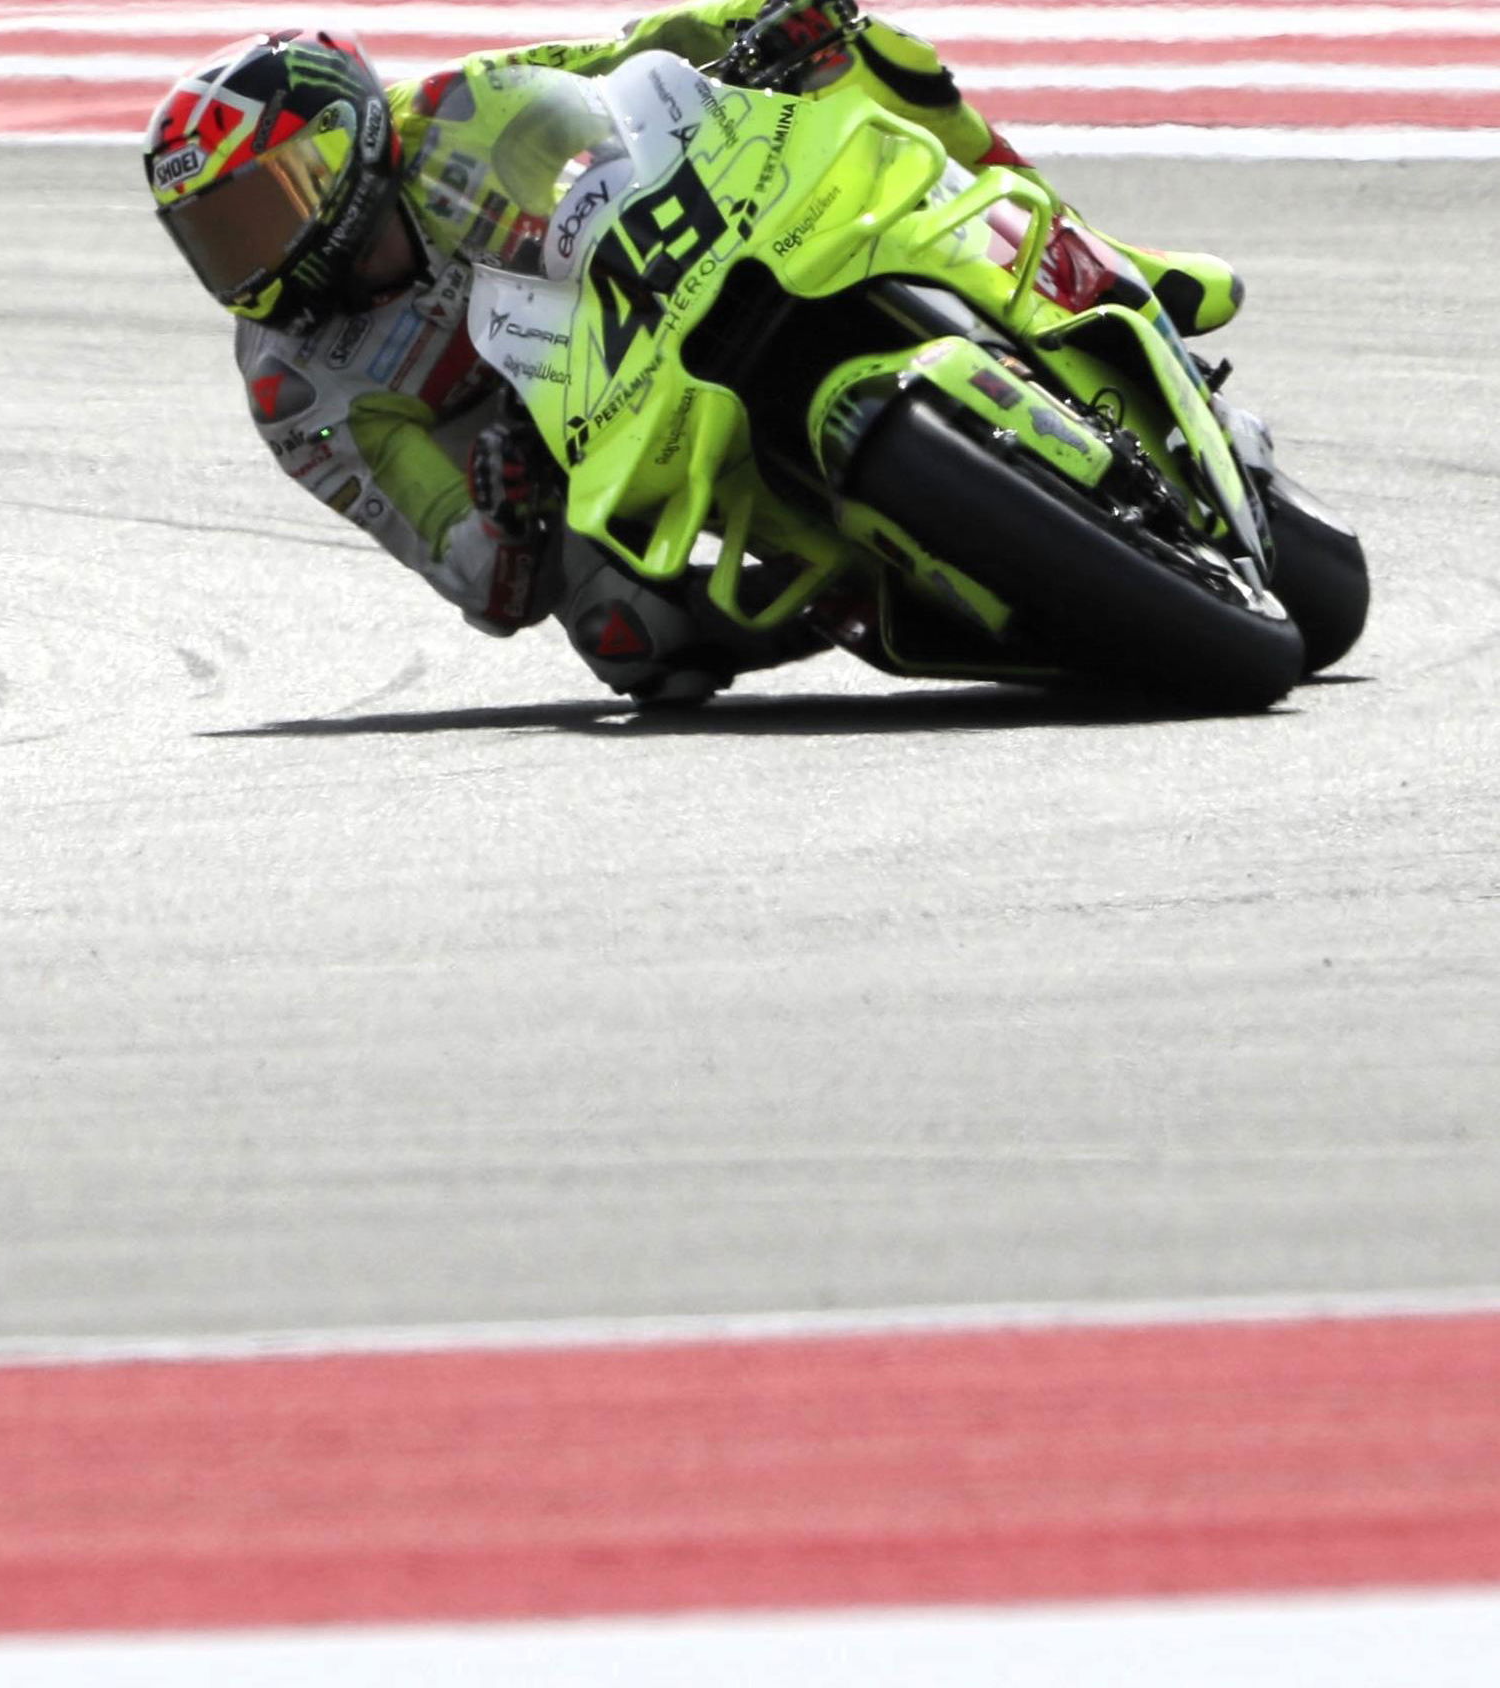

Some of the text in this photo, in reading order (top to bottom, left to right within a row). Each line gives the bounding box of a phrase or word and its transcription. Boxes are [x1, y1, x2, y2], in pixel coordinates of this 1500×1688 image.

[156, 150, 198, 186] SHOEI
[755, 103, 797, 192] PERTAMINA
[558, 180, 609, 259] ebay
[588, 158, 729, 381] 49
[664, 258, 717, 332] HERO
[506, 323, 570, 348] CUPRA
[594, 354, 663, 430] PERTAMINA
